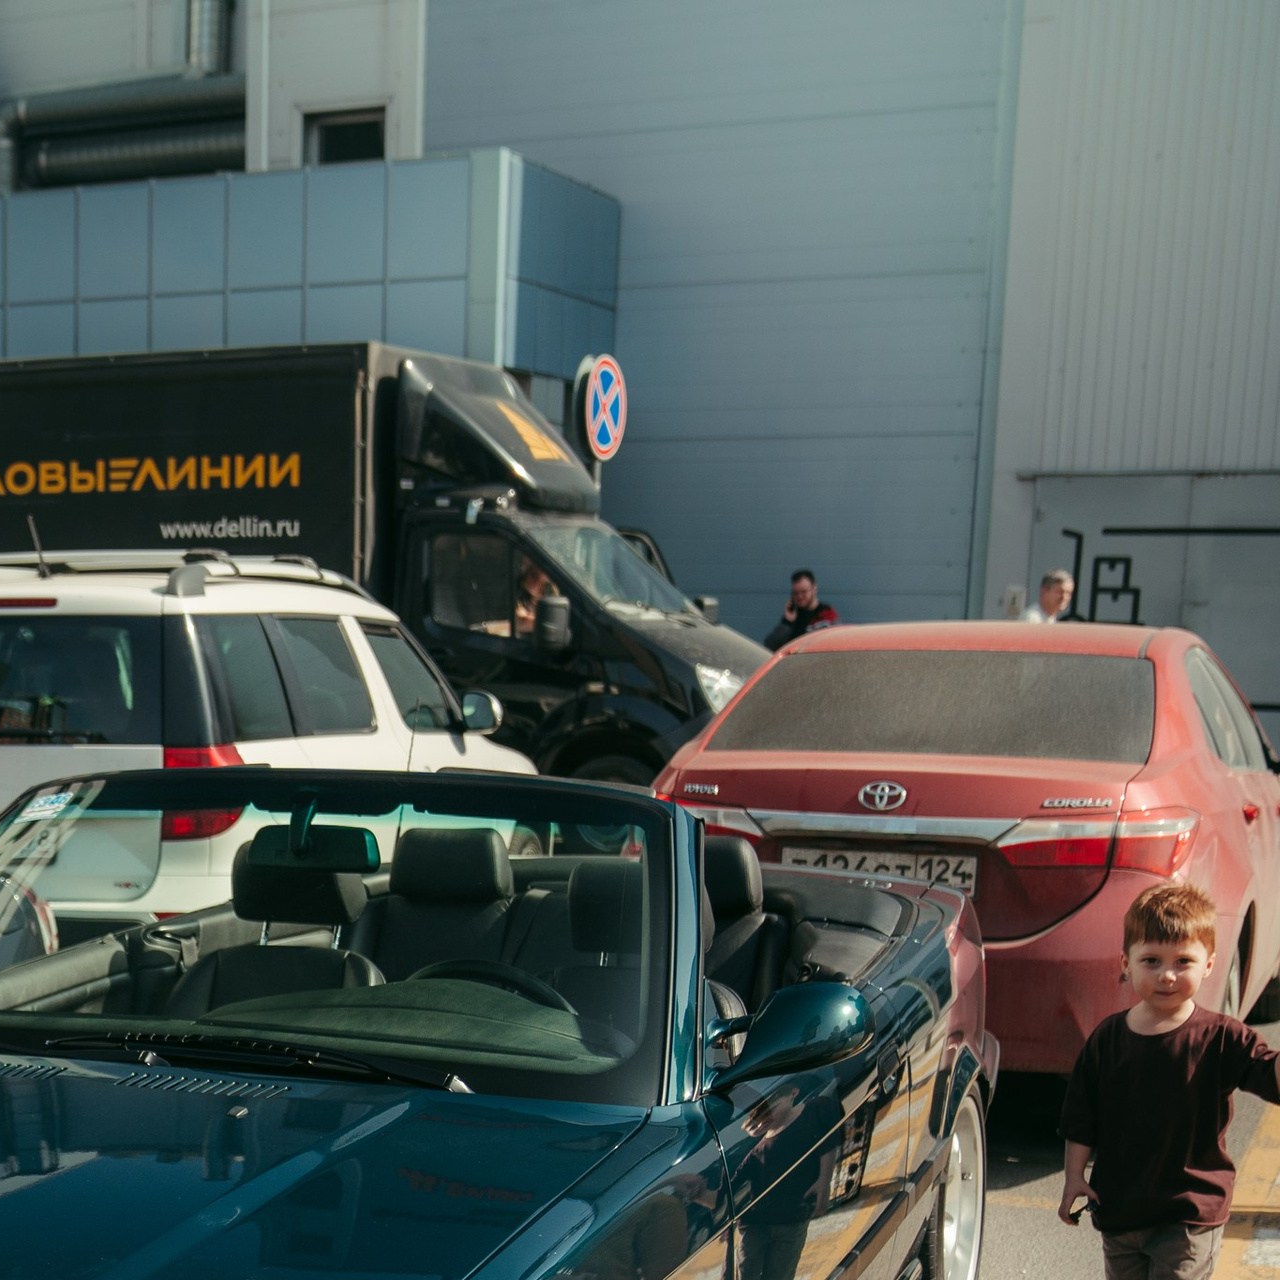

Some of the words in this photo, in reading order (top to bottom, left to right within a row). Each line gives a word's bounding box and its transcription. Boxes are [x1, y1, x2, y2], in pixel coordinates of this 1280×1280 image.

[160, 515, 300, 539] www.dellin.ru
[1042, 797, 1113, 809] COROLLA
[921, 857, 964, 884] 124
